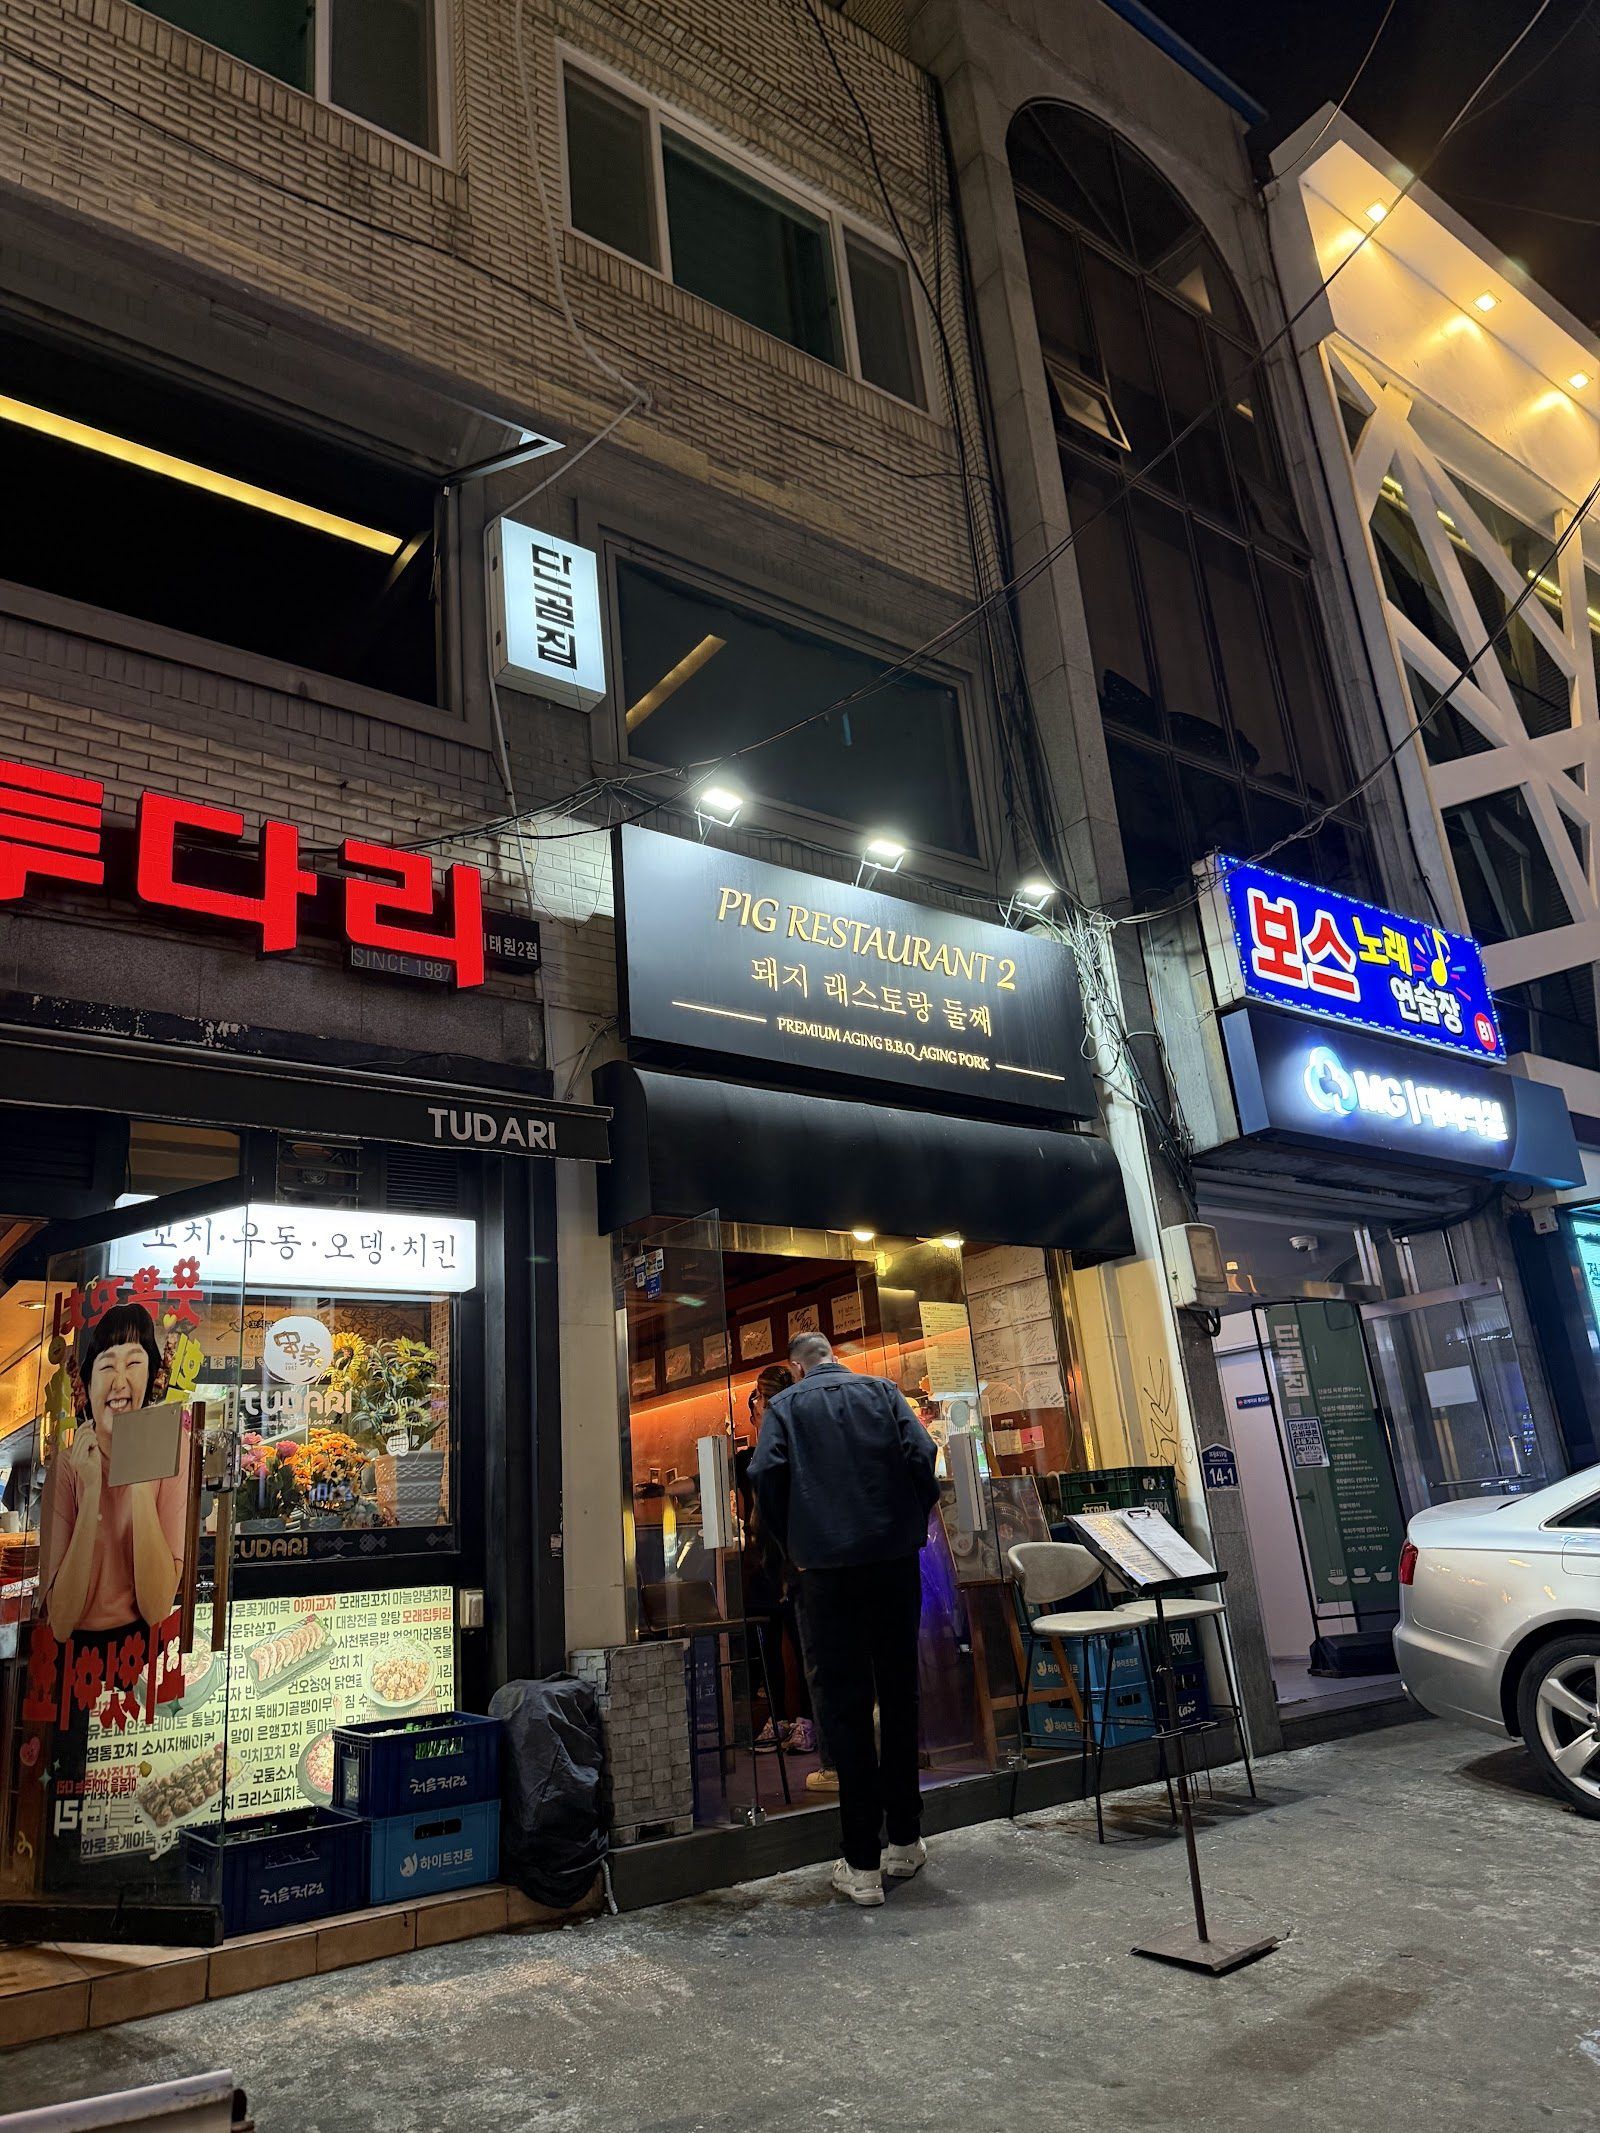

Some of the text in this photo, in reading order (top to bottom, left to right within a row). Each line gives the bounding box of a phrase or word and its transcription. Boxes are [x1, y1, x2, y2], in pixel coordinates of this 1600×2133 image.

[717, 887, 1017, 991] PIG RESTAURANT 2
[1246, 887, 1361, 1003] 보스
[1352, 916, 1413, 976] 노래
[352, 947, 452, 982] SINCE 1987
[751, 956, 993, 1038] 돼지 래스토랑 둘째
[1391, 976, 1463, 1036] 연습장
[777, 1016, 841, 1043] PREMIUM
[842, 1031, 883, 1051] AGING
[958, 1053, 990, 1071] PORK
[1478, 1019, 1494, 1044] B1
[428, 1106, 556, 1150] TUDARI
[240, 1390, 352, 1416] TUDARI
[1209, 1467, 1235, 1485] 14-1
[226, 1600, 291, 1618] 로꽃게어묵
[293, 1596, 337, 1613] 야끼교자
[339, 1591, 391, 1610] 모래집꼬치
[392, 1587, 452, 1605] 마늘양념치킨
[336, 1612, 378, 1630] 대창전골
[380, 1610, 400, 1626] 알탕
[402, 1606, 452, 1624] 모래집튀김
[86, 1741, 138, 1764] 염통꼬치
[256, 1720, 302, 1741] 은행꼬치
[409, 1775, 468, 1794] 처음처럼
[420, 1848, 474, 1870] 하이트진로
[259, 1882, 325, 1906] 처음처럼
